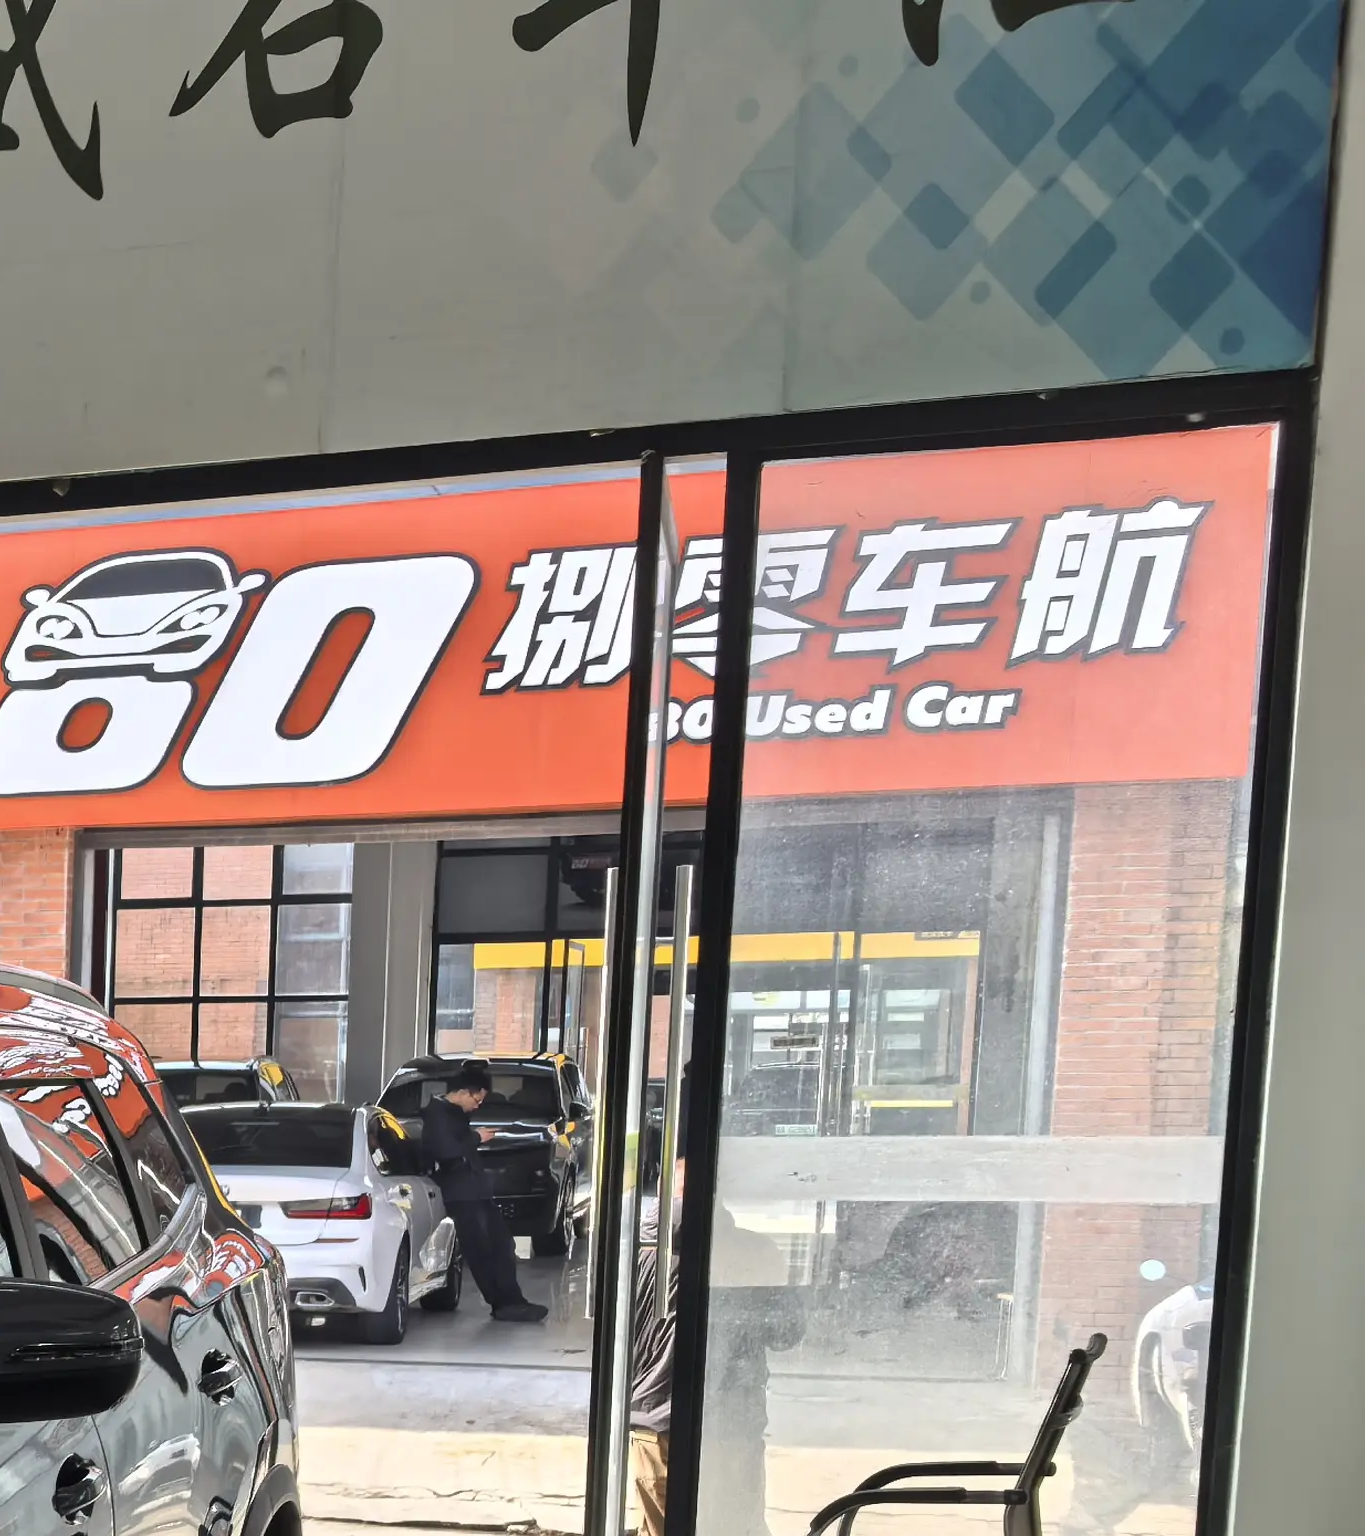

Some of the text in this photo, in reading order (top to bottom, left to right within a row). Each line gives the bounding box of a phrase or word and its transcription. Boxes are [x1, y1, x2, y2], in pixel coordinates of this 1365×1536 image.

[481, 495, 1214, 696] 捌零车航
[745, 685, 893, 737] Used
[905, 686, 1017, 734] Car
